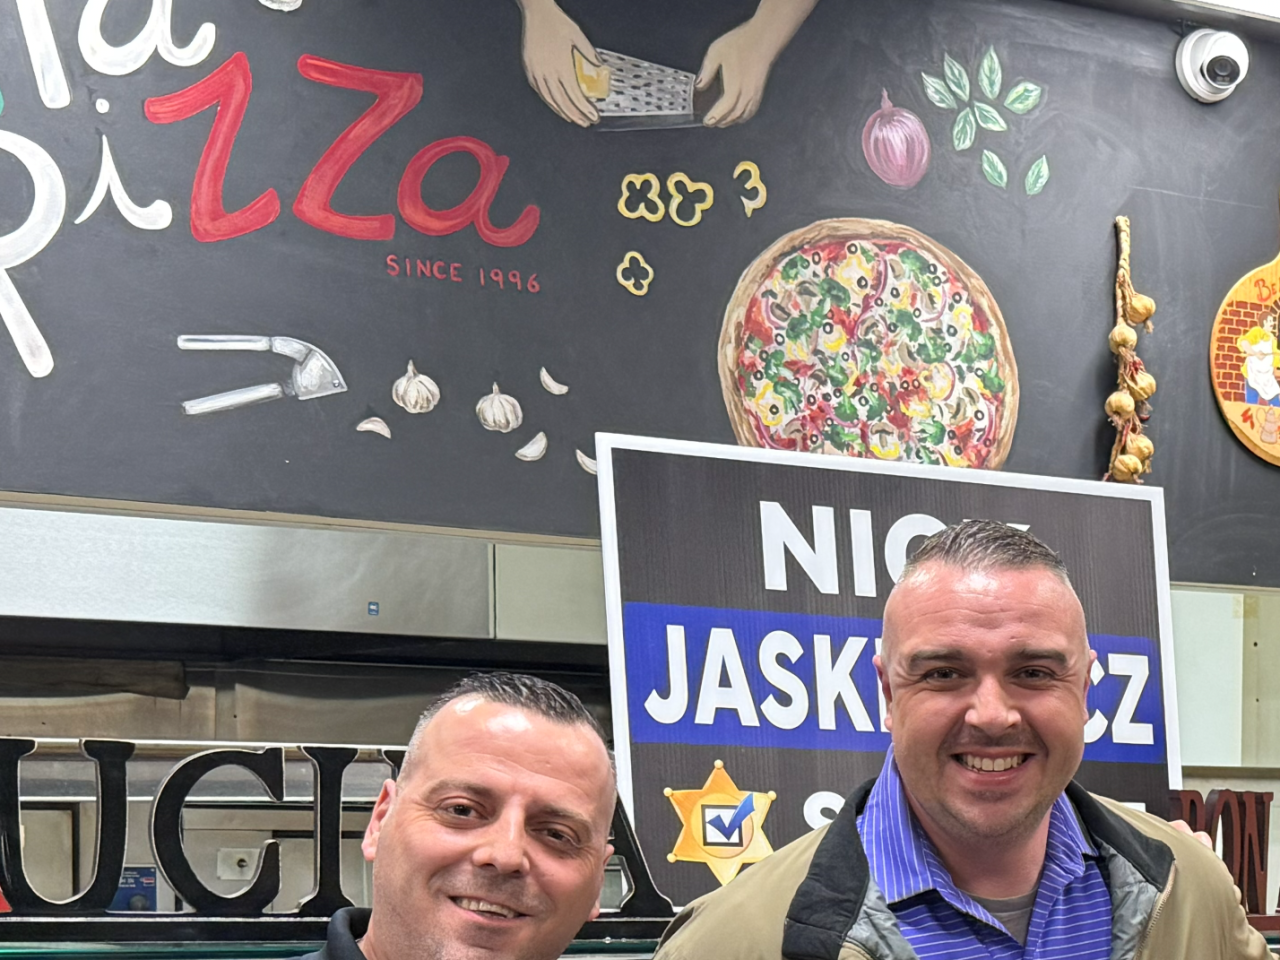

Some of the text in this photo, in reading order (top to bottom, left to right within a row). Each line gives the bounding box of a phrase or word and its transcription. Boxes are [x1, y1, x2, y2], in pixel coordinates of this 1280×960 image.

[386, 254, 541, 293] SINCE 1996
[759, 500, 1031, 598] NIC
